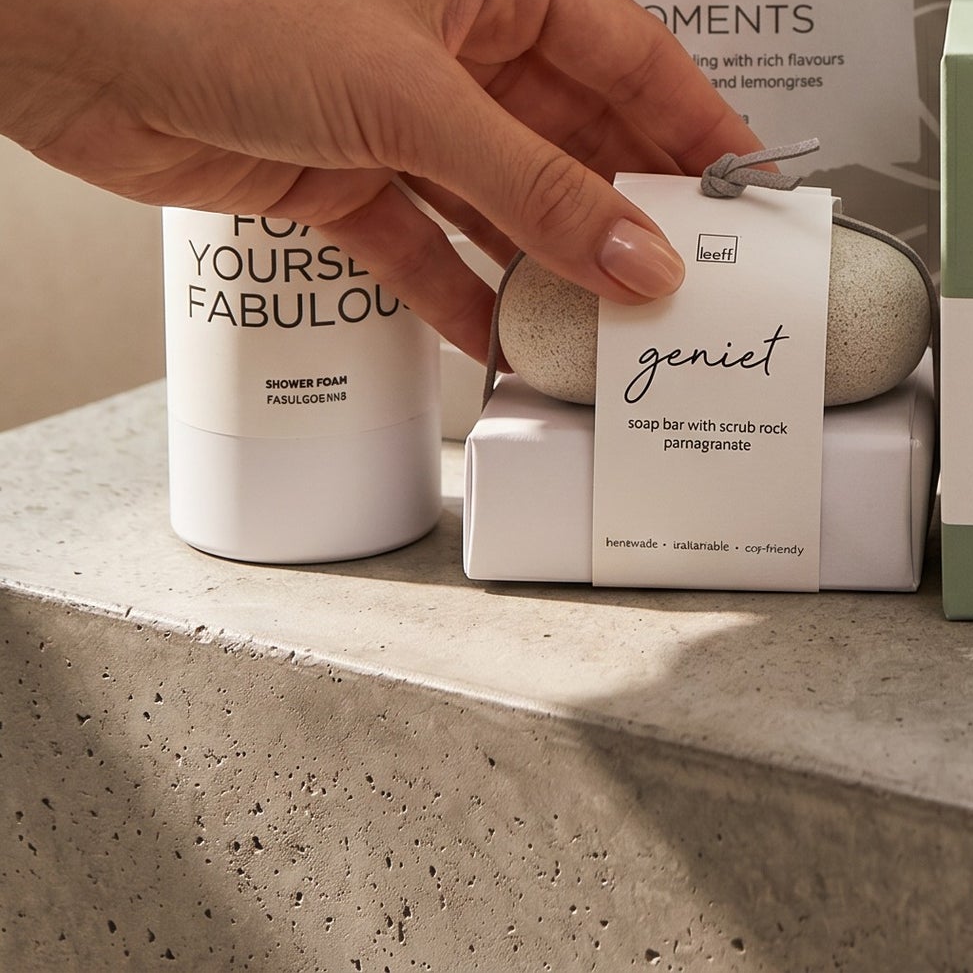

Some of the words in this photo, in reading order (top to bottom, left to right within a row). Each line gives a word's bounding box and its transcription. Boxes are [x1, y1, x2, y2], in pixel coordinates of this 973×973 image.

[644, 4, 815, 35] MENTS
[723, 54, 753, 67] with
[757, 54, 783, 67] rich
[788, 53, 844, 66] flavours
[699, 247, 733, 261] leeff
[188, 284, 409, 328] FABULOU
[624, 325, 789, 403] geniet
[265, 379, 314, 389] SHOWER
[628, 420, 659, 432] soap
[663, 418, 684, 430] bar
[688, 420, 715, 431] with
[720, 421, 755, 433] scrub
[760, 422, 787, 434] rock
